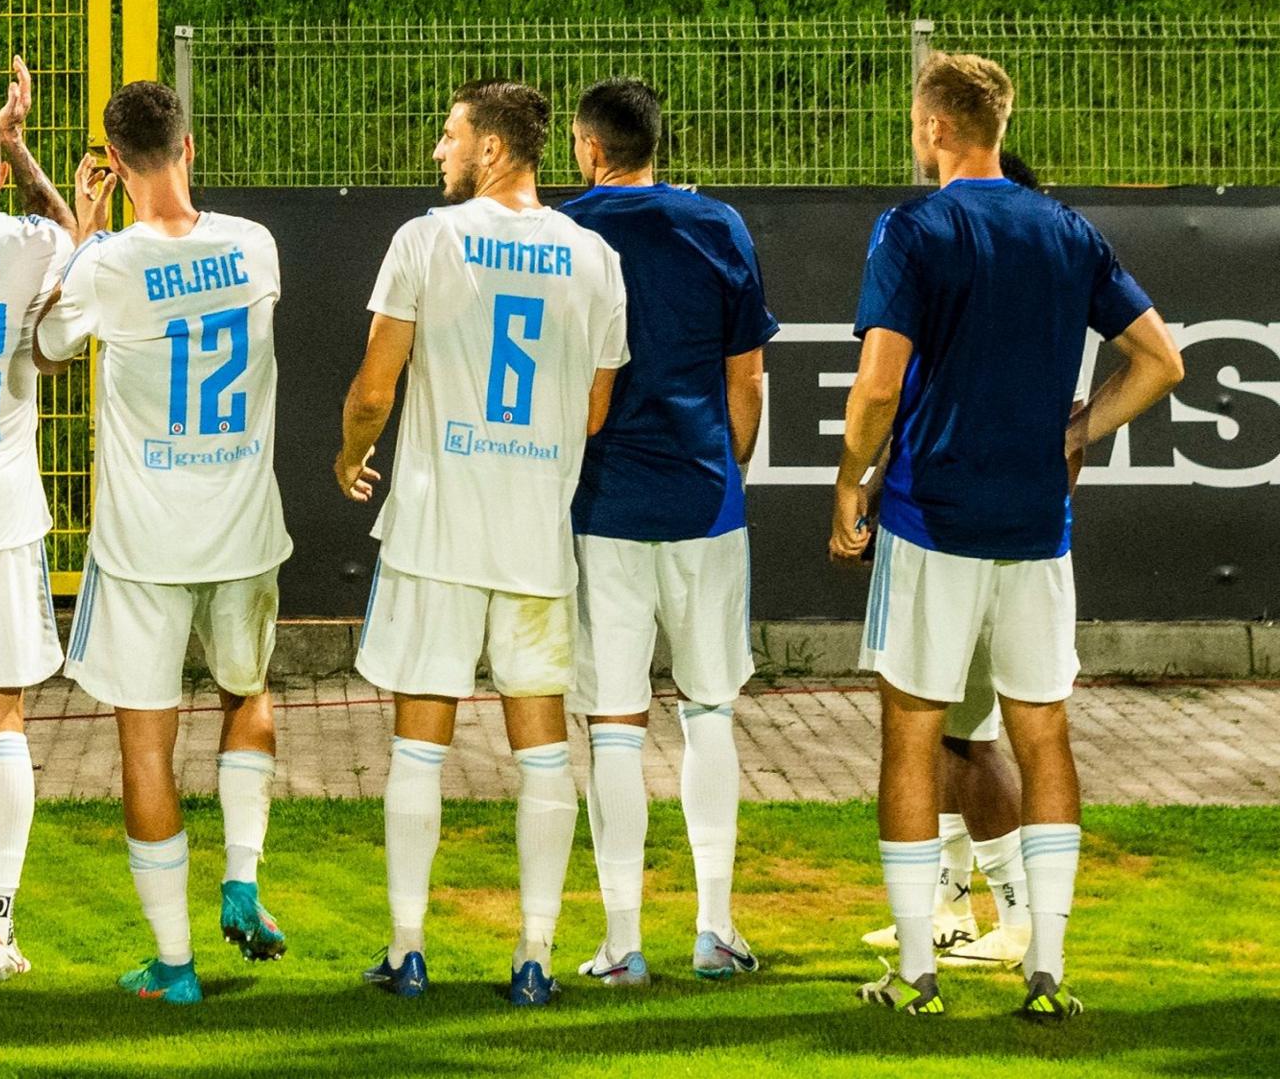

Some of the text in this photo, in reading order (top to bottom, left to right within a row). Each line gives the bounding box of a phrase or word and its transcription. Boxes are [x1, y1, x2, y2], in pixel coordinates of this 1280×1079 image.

[463, 235, 573, 277] WIMMER
[164, 306, 250, 436] 12
[485, 293, 545, 426] 6
[174, 439, 261, 466] grafobal
[473, 438, 559, 460] grafobal
